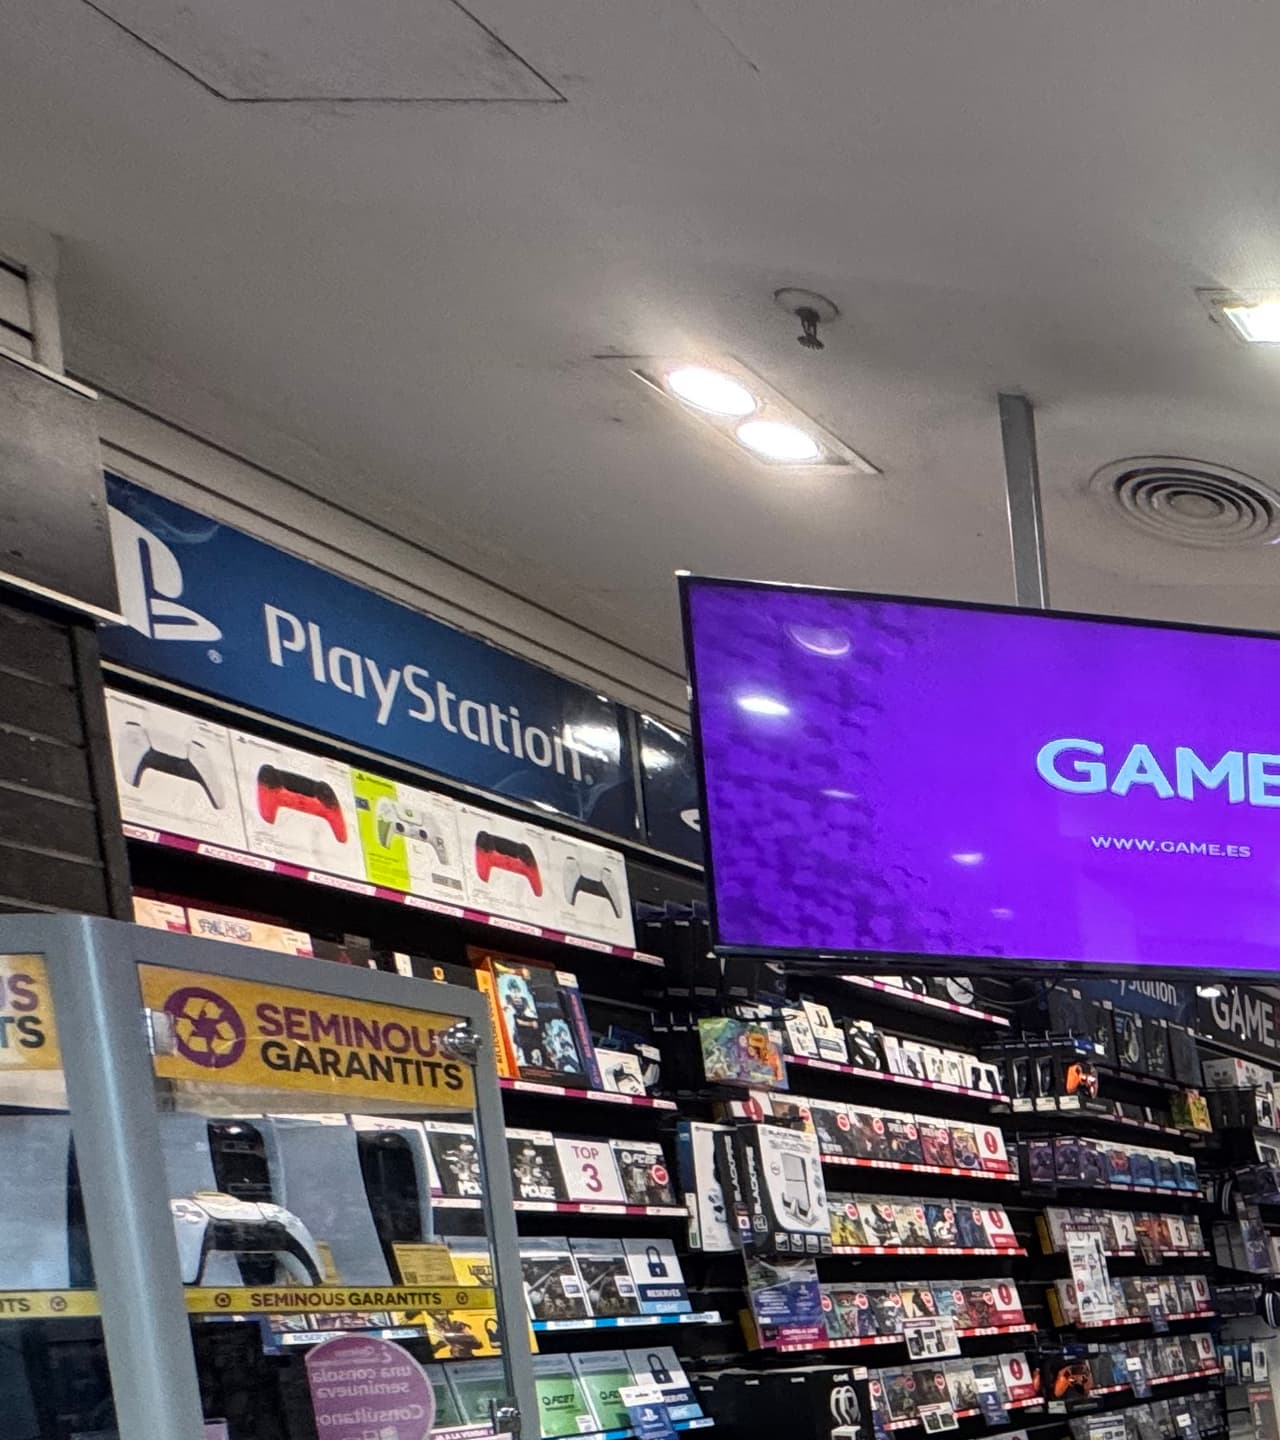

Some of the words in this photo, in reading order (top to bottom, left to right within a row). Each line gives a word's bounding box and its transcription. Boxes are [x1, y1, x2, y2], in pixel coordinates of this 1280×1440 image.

[264, 603, 583, 780] PlayStation
[1090, 834, 1251, 858] WWW.GAME.ES
[258, 1003, 462, 1061] SEMINOUS
[1211, 985, 1275, 1046] GAME
[261, 1040, 464, 1091] GARANTITS
[571, 1145, 599, 1160] TOP
[581, 1163, 602, 1193] 3
[251, 1292, 345, 1307] SEMINOUS
[348, 1292, 442, 1307] GARANTITS
